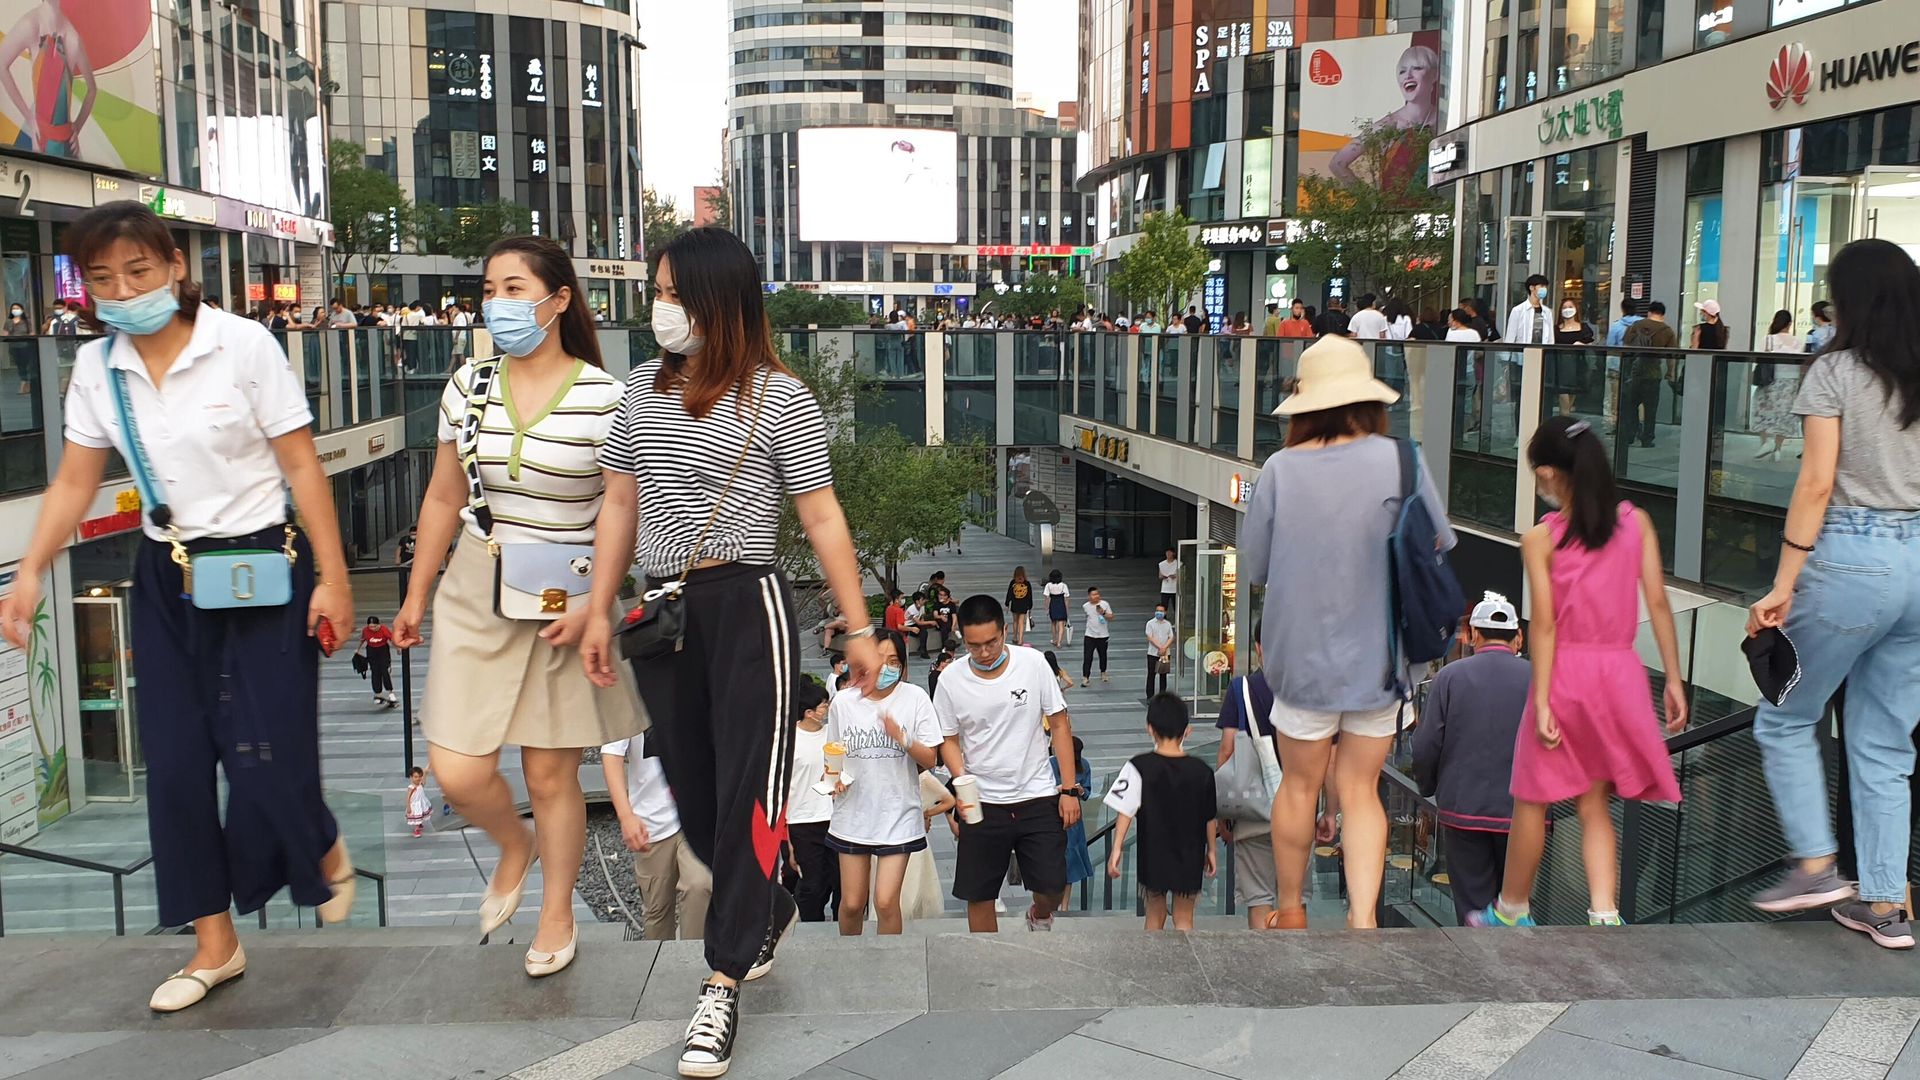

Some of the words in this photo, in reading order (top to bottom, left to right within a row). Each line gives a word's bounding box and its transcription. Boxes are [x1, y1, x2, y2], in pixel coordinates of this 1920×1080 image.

[1267, 20, 1293, 35] SPA
[479, 54, 492, 100] TATTOO
[1194, 25, 1211, 93] SPA
[1313, 74, 1341, 84] SOHO
[1556, 89, 1624, 141] 大地飞歌
[481, 135, 496, 172] 图文
[531, 138, 546, 174] 快印
[1214, 277, 1224, 314] 立等可取
[1111, 779, 1129, 800] 2
